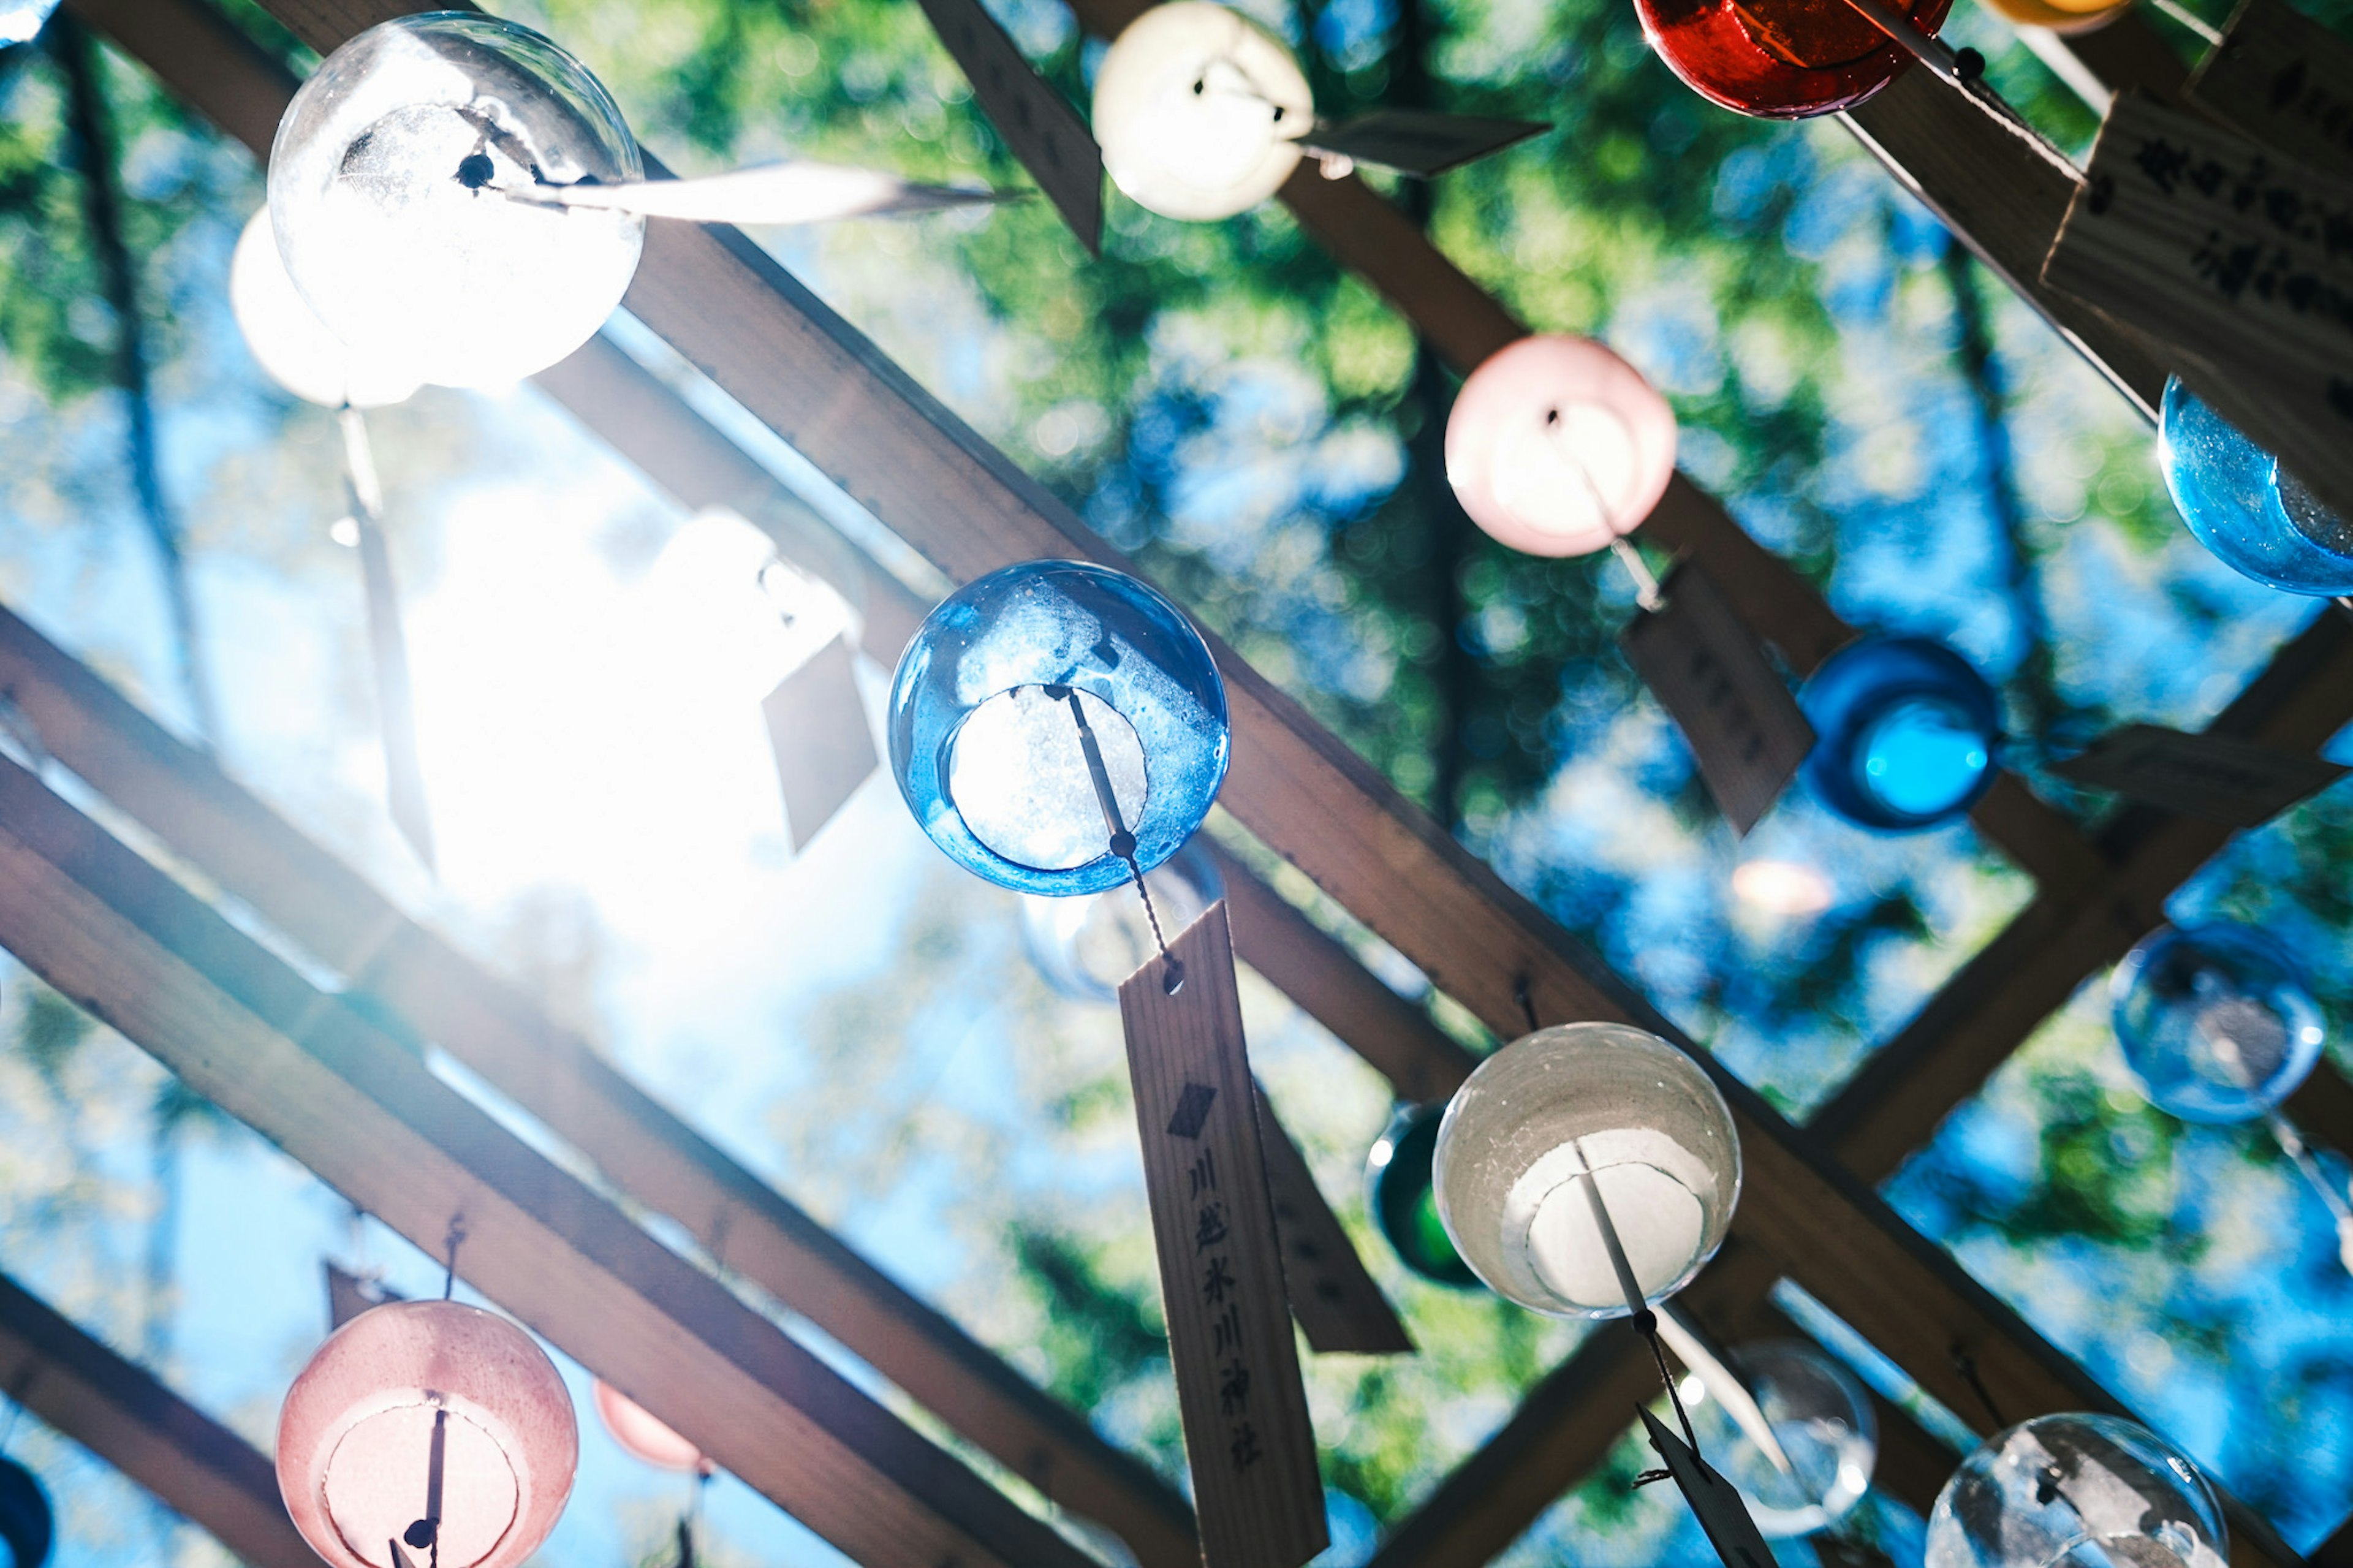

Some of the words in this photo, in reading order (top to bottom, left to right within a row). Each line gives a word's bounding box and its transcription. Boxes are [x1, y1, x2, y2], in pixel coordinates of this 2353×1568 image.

[1189, 1148, 1261, 1474] 川越氷川神社
